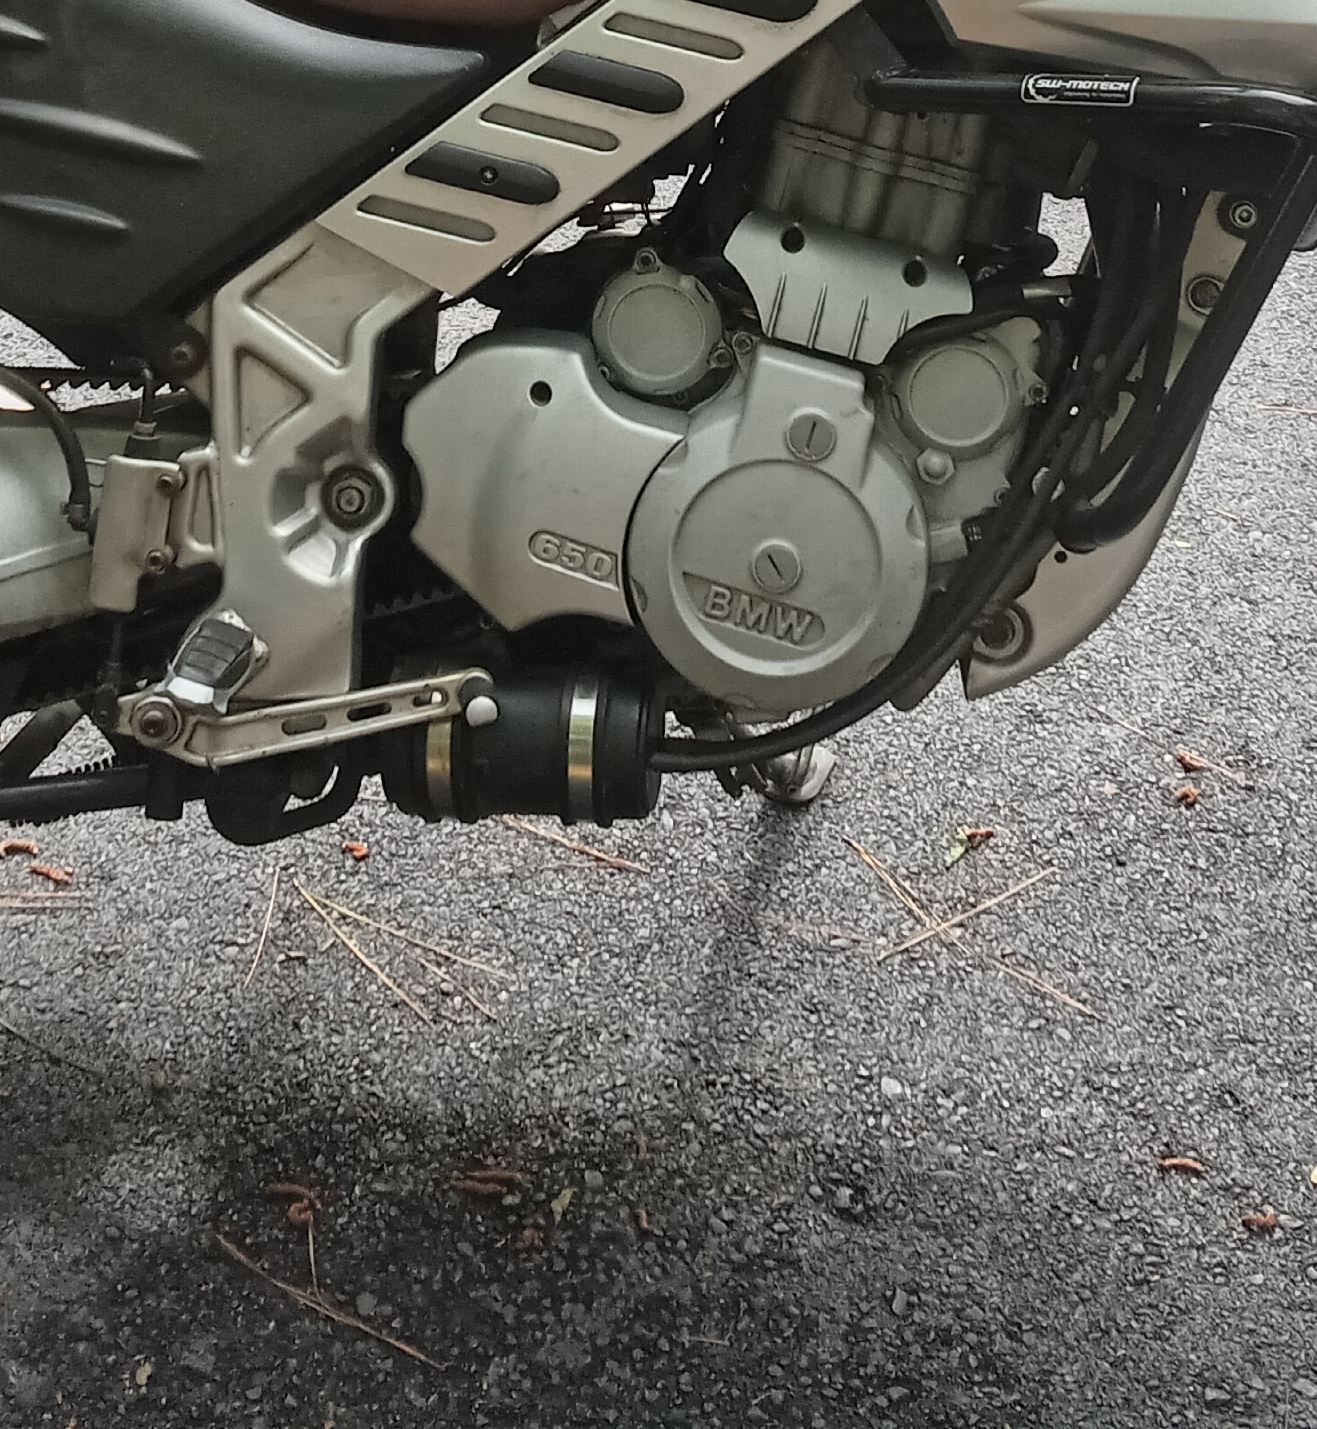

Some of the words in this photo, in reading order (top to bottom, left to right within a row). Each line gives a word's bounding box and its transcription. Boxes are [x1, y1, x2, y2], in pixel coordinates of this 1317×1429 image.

[1035, 78, 1131, 91] SW-MOTECH
[532, 533, 615, 578] 650
[703, 584, 815, 647] BMW
